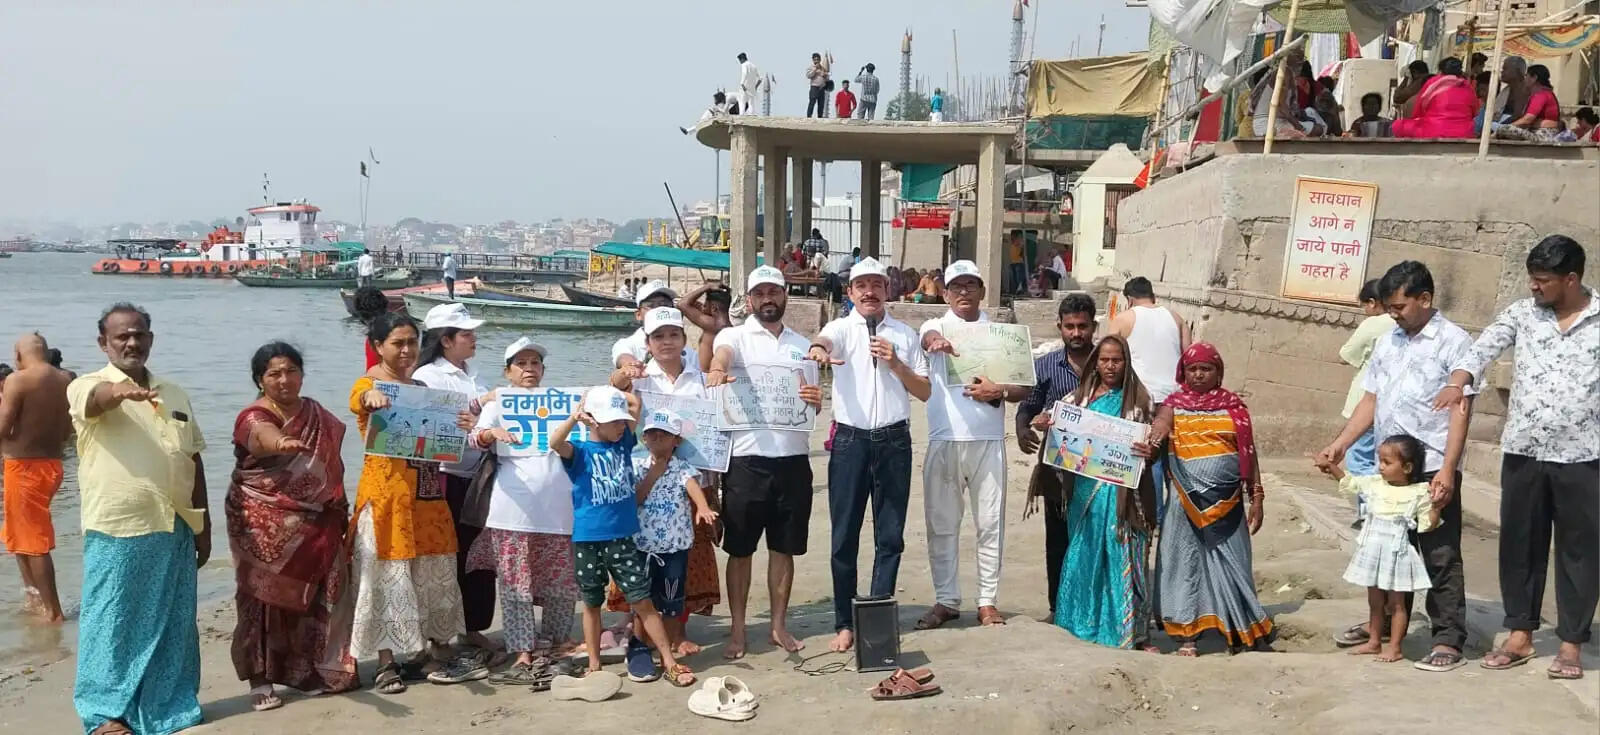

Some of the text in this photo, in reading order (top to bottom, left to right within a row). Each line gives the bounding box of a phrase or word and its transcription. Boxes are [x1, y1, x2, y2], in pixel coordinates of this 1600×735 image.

[1309, 191, 1363, 208] सावधान
[1309, 213, 1357, 232] आगे न
[1296, 236, 1361, 257] जाये पानी
[1301, 262, 1351, 281] गहरा है
[501, 387, 572, 414] नमामि
